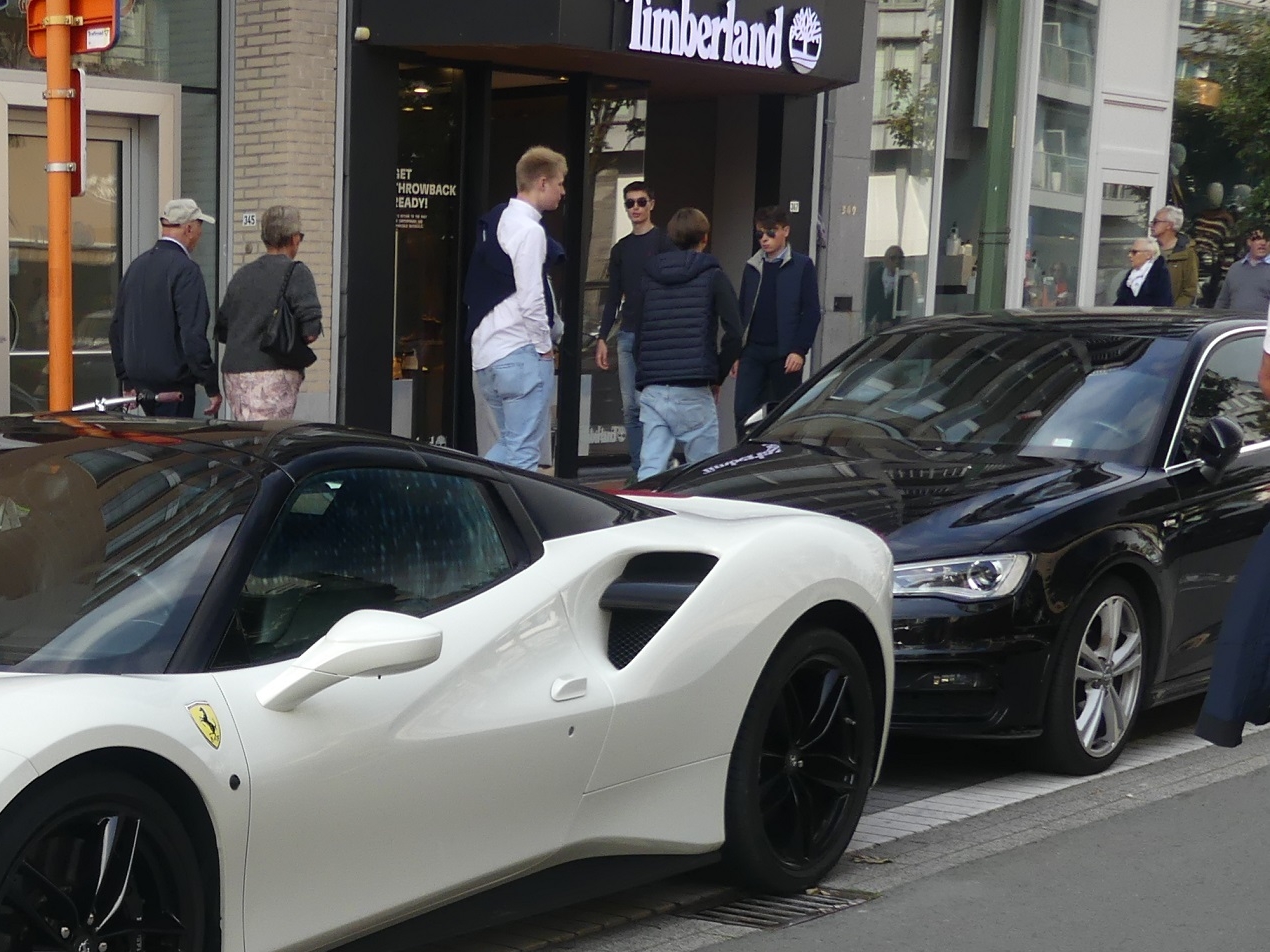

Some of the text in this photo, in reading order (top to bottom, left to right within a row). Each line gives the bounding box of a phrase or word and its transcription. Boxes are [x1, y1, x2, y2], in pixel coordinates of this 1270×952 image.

[625, 0, 784, 69] Timberland
[396, 182, 457, 196] HROWBACK
[243, 215, 255, 225] 345
